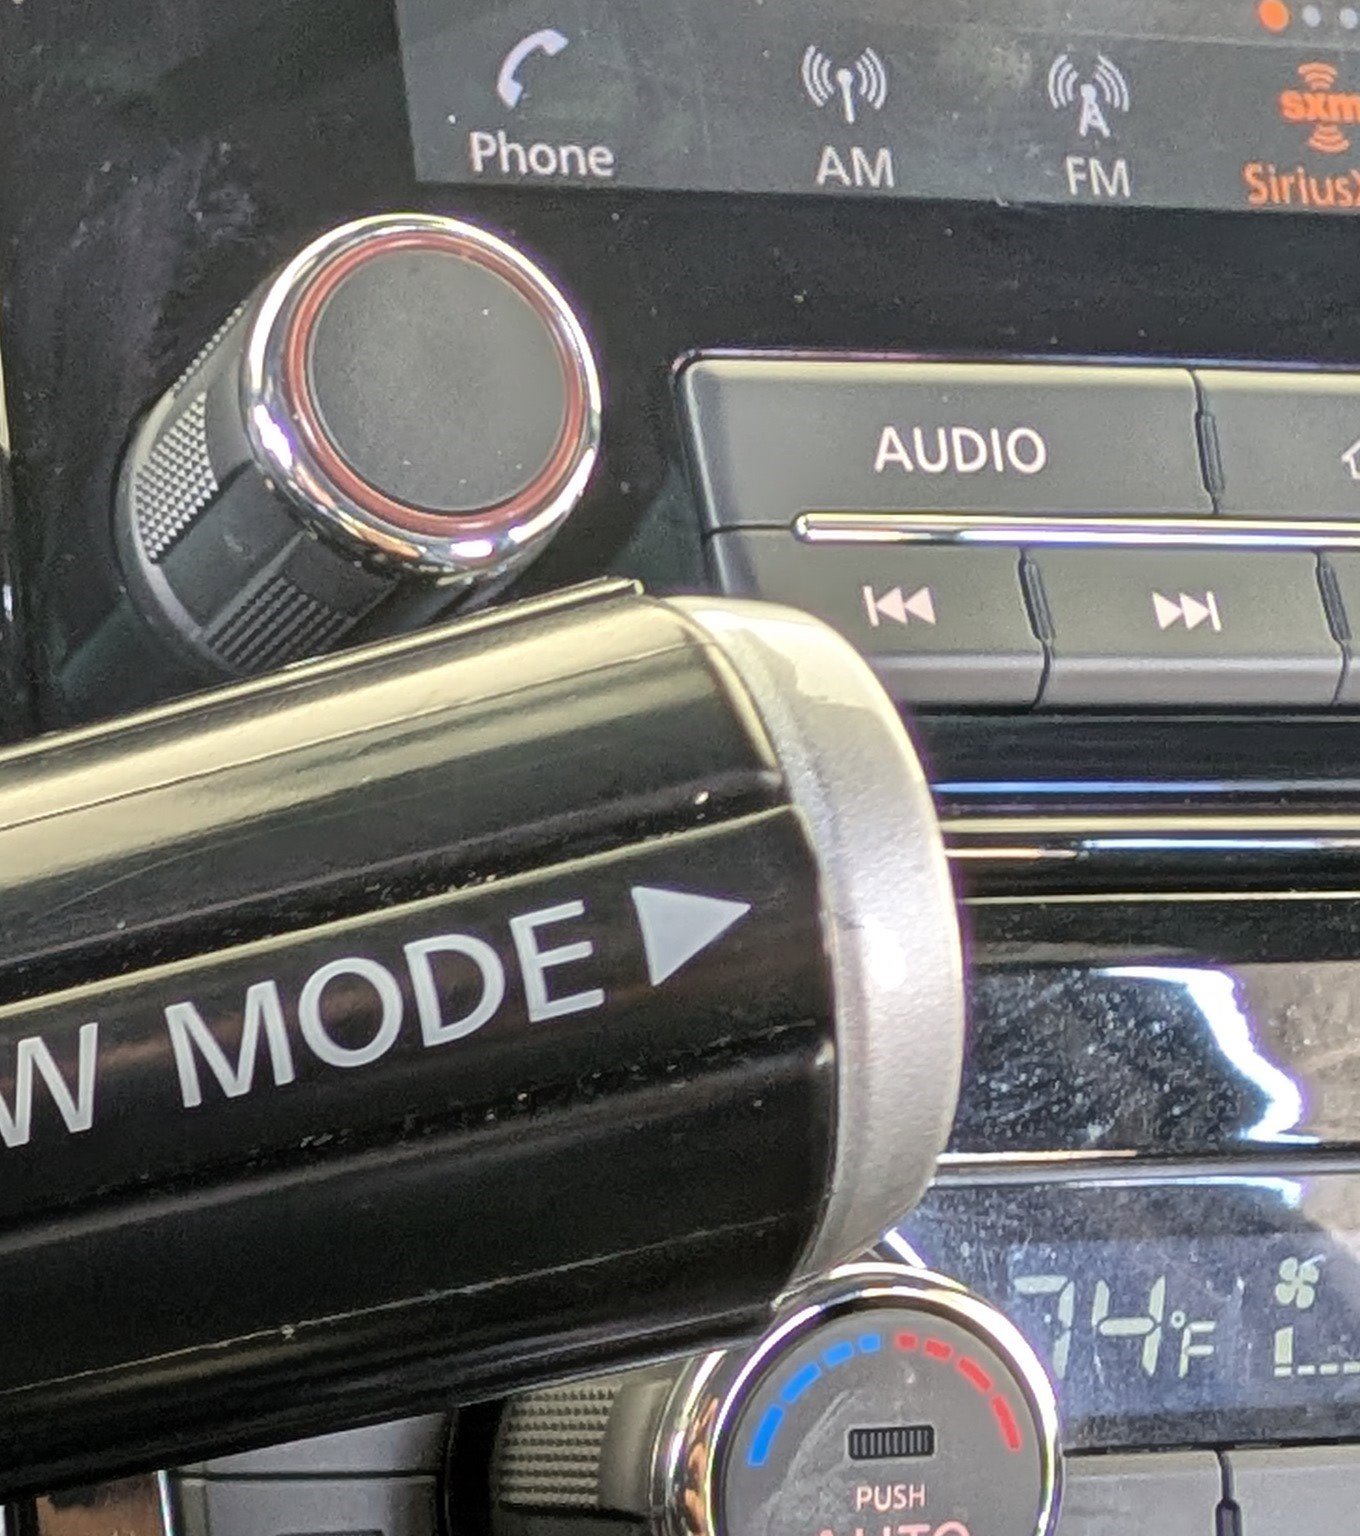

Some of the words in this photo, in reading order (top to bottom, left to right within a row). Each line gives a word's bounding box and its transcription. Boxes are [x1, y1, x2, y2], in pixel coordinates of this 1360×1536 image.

[469, 132, 614, 178] Phone
[816, 147, 894, 188] AM
[1066, 156, 1131, 198] FM
[874, 428, 1047, 474] AUDIO
[165, 899, 605, 1108] MODE
[855, 1484, 925, 1512] PUSH
